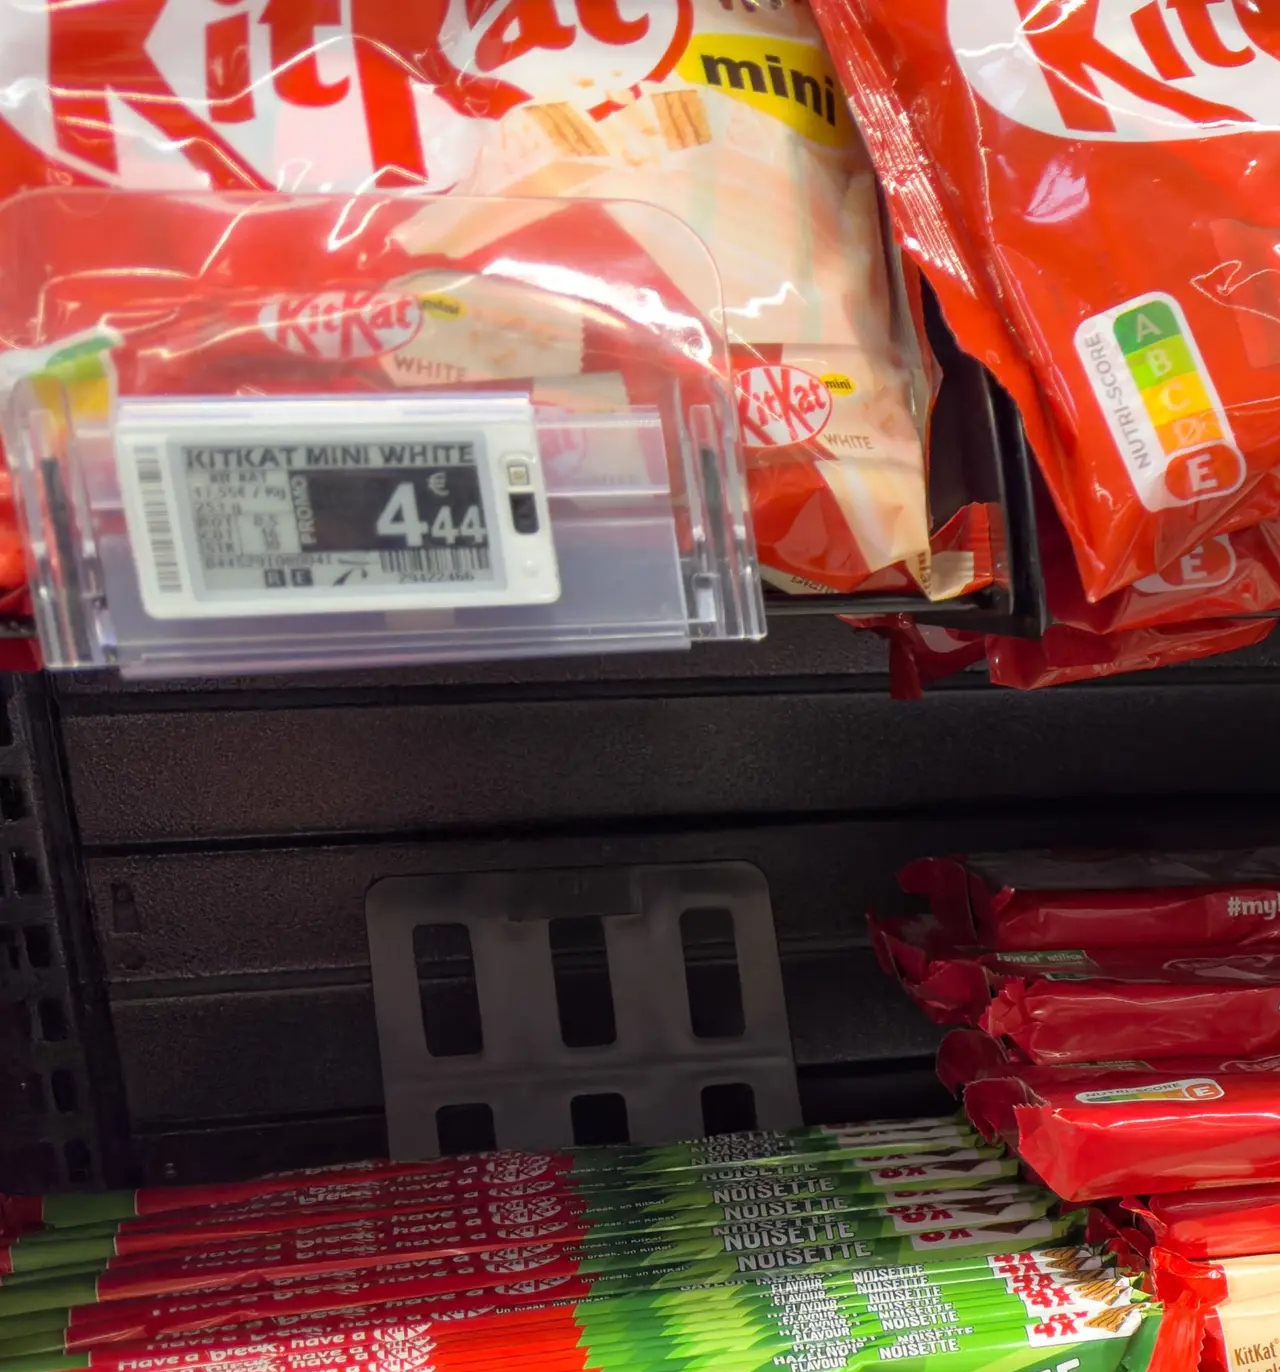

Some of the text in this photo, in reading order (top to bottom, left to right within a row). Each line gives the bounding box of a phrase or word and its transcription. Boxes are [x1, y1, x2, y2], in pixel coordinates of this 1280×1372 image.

[702, 48, 838, 127] mini
[276, 293, 416, 358] KitKat
[394, 355, 469, 383] WHITE
[824, 377, 853, 391] mini
[1083, 331, 1153, 471] NUTRI-SCORE
[187, 443, 474, 469] KITKAT MINI WHITE
[823, 432, 873, 452] WHITE
[291, 474, 316, 545] PROMO
[712, 1177, 836, 1205] NOISETTE
[722, 1196, 849, 1222] NOISETTE
[723, 1221, 856, 1253] NOISETTE
[736, 1241, 872, 1273] NOISETTE
[291, 1330, 366, 1350] have a
[1234, 1338, 1279, 1368] KitKat
